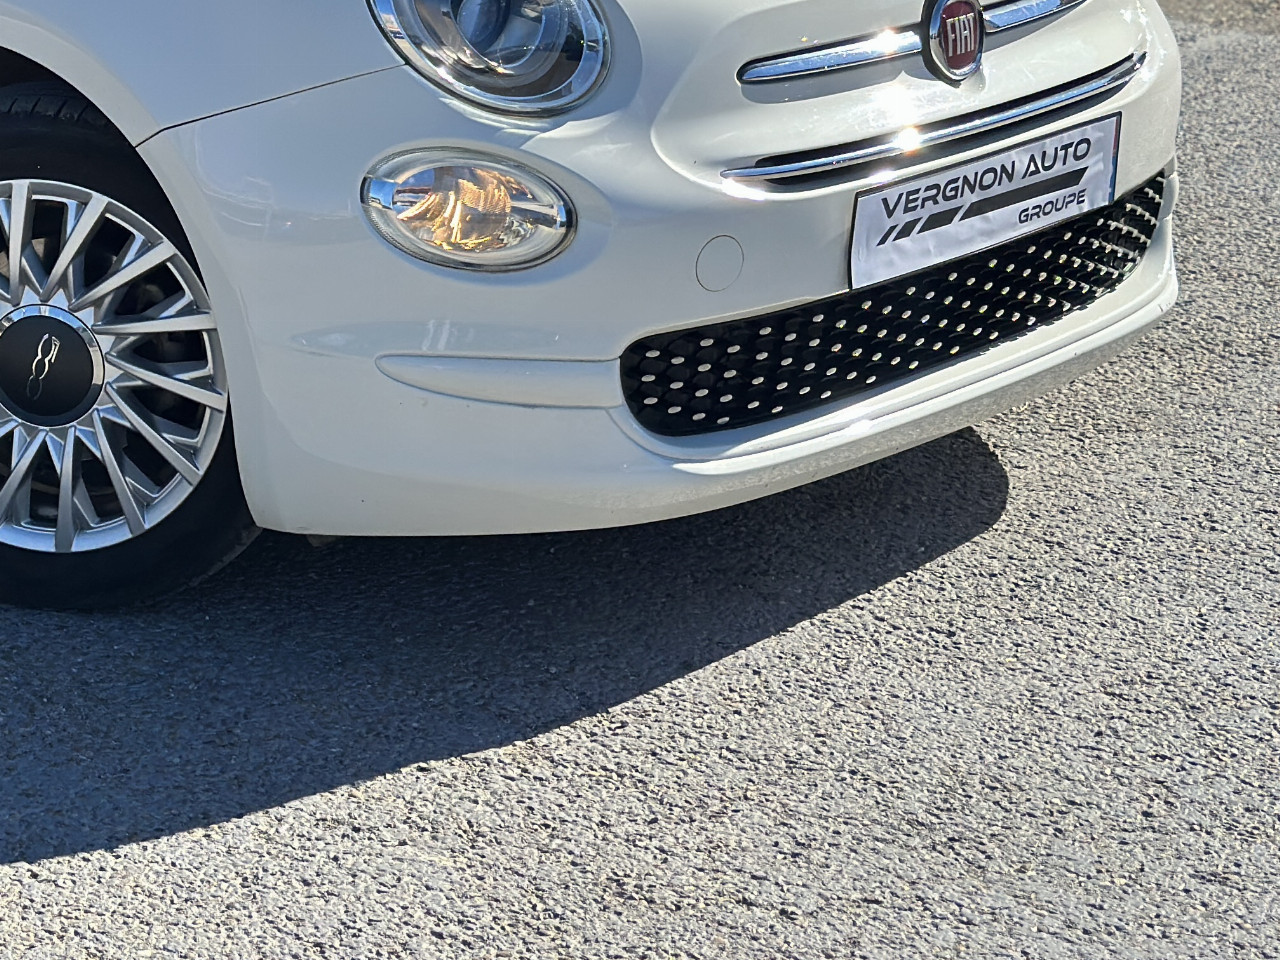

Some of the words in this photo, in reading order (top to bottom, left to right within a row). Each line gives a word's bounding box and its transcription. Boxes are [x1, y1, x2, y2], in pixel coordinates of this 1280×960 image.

[945, 12, 976, 57] FIAT
[880, 160, 1016, 220] VERGNON
[1021, 137, 1092, 180] AUTO
[1018, 188, 1087, 224] GROUPE
